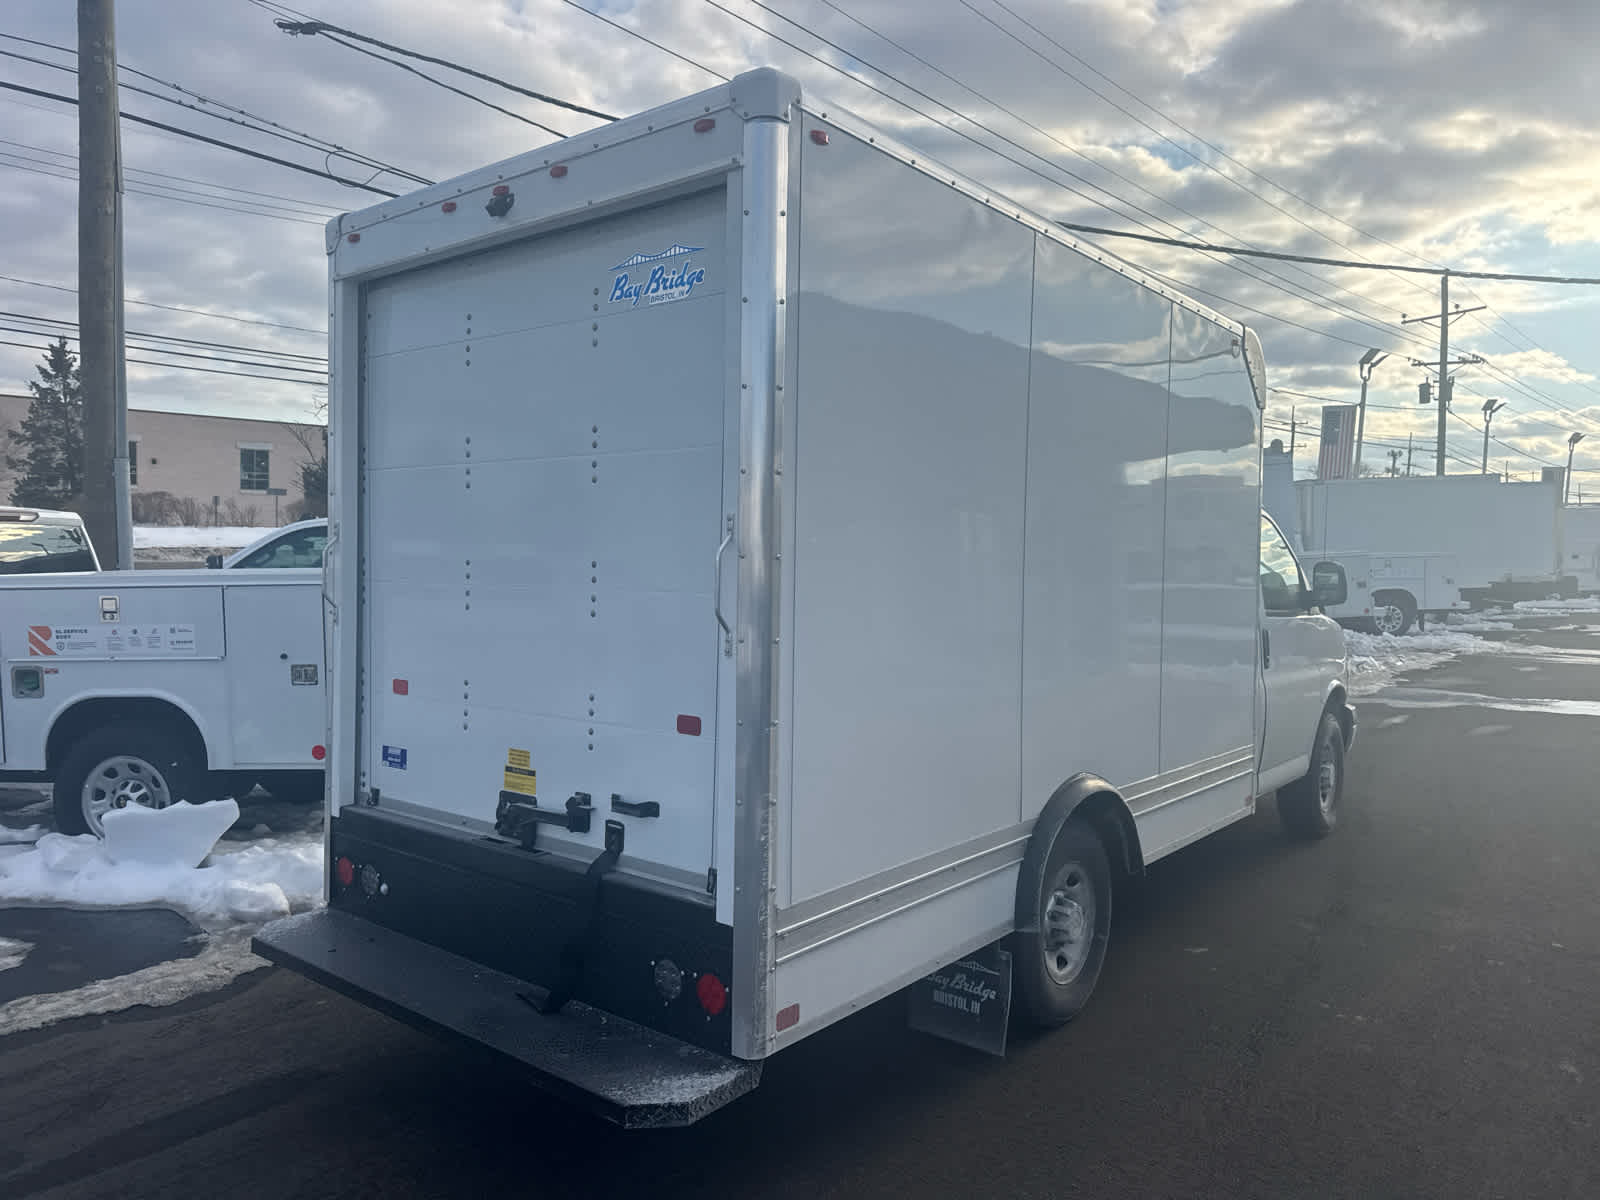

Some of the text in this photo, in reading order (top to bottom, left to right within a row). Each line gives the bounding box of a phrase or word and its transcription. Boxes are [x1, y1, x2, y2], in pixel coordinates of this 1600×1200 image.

[609, 261, 705, 306] Bay Bridge
[950, 974, 997, 1002] Bridge
